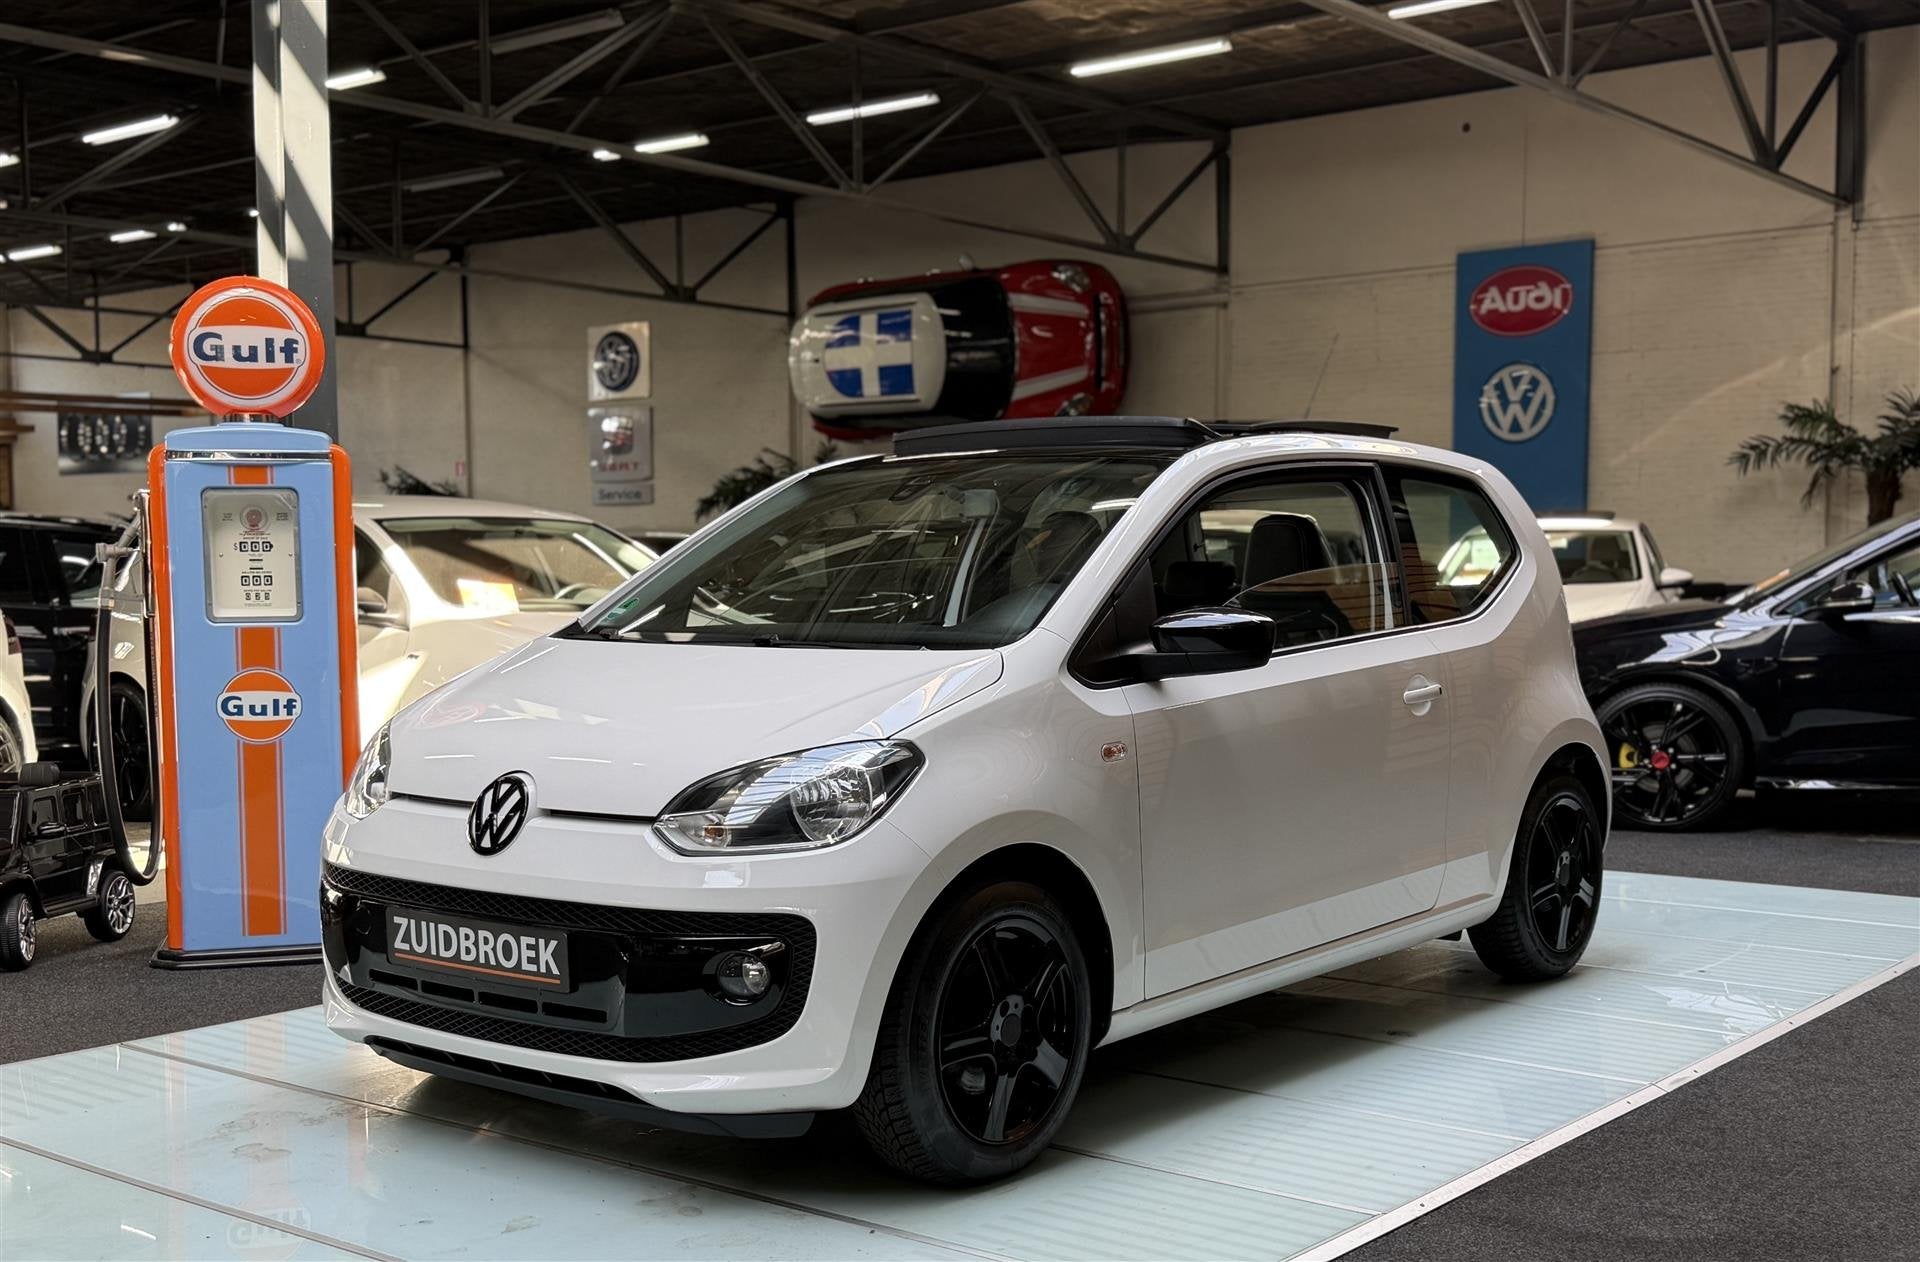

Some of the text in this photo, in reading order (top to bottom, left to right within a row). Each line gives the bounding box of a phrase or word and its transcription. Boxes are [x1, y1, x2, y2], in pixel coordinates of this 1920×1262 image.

[192, 331, 300, 364] Gulf
[220, 695, 298, 717] Gulf
[393, 915, 561, 976] ZUIDBROEK
